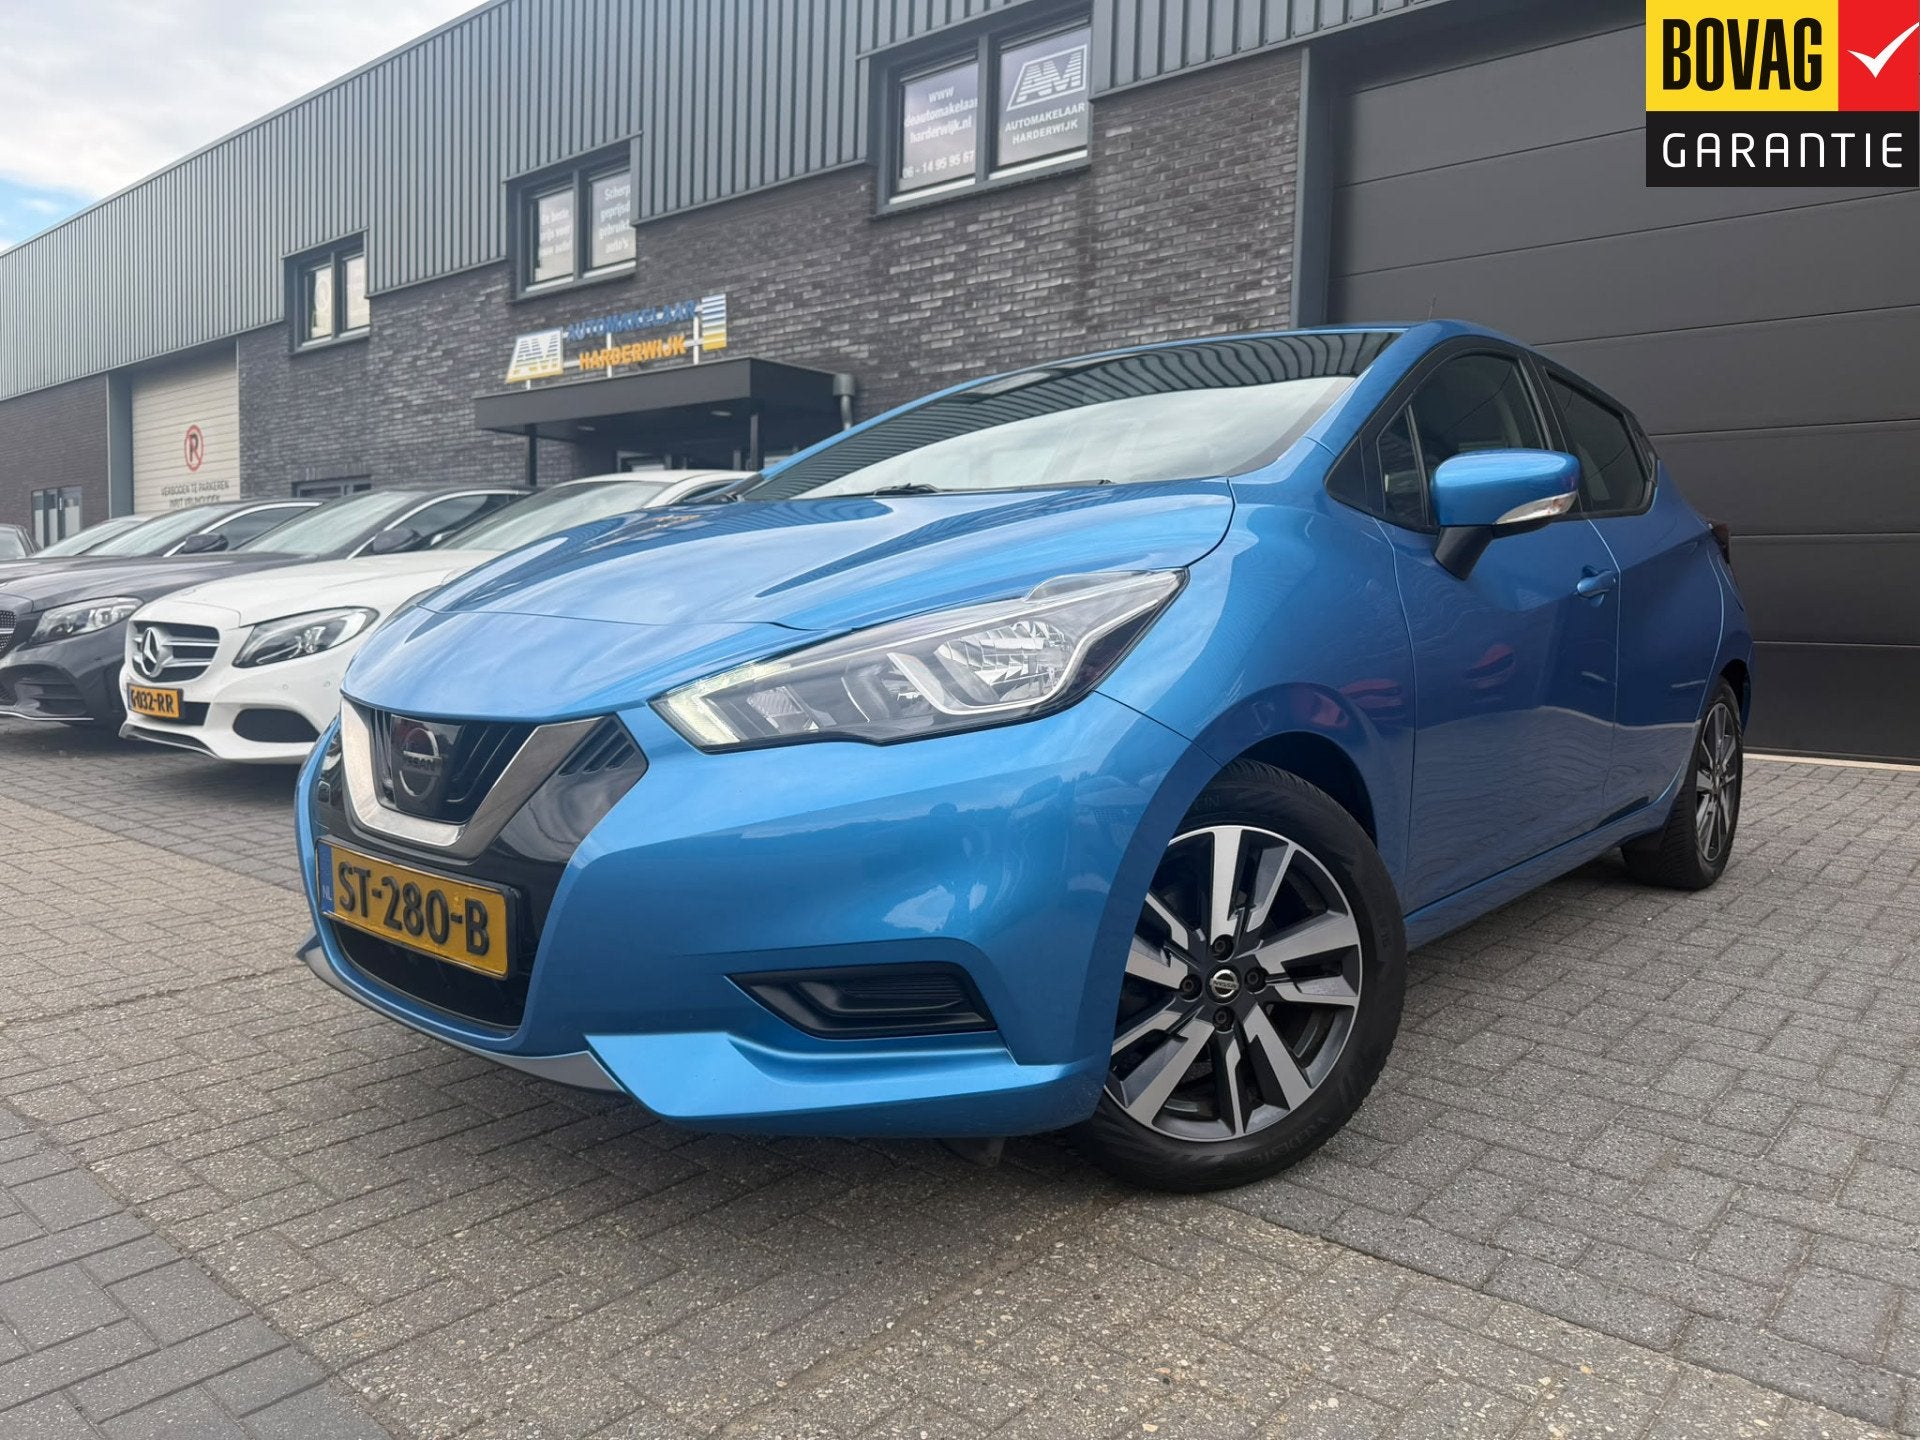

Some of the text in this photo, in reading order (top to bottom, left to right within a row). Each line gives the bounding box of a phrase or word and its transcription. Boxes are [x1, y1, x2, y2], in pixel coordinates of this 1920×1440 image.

[1016, 51, 1082, 103] AM
[909, 115, 972, 144] harderwijk.nl
[1005, 102, 1085, 132] AUTOMAKELAAR
[1012, 119, 1078, 145] HARDERWIJK
[566, 299, 698, 341] AUTOMAKELAAR
[579, 335, 687, 370] HARDERWIJK
[338, 861, 490, 956] ST-280-B
